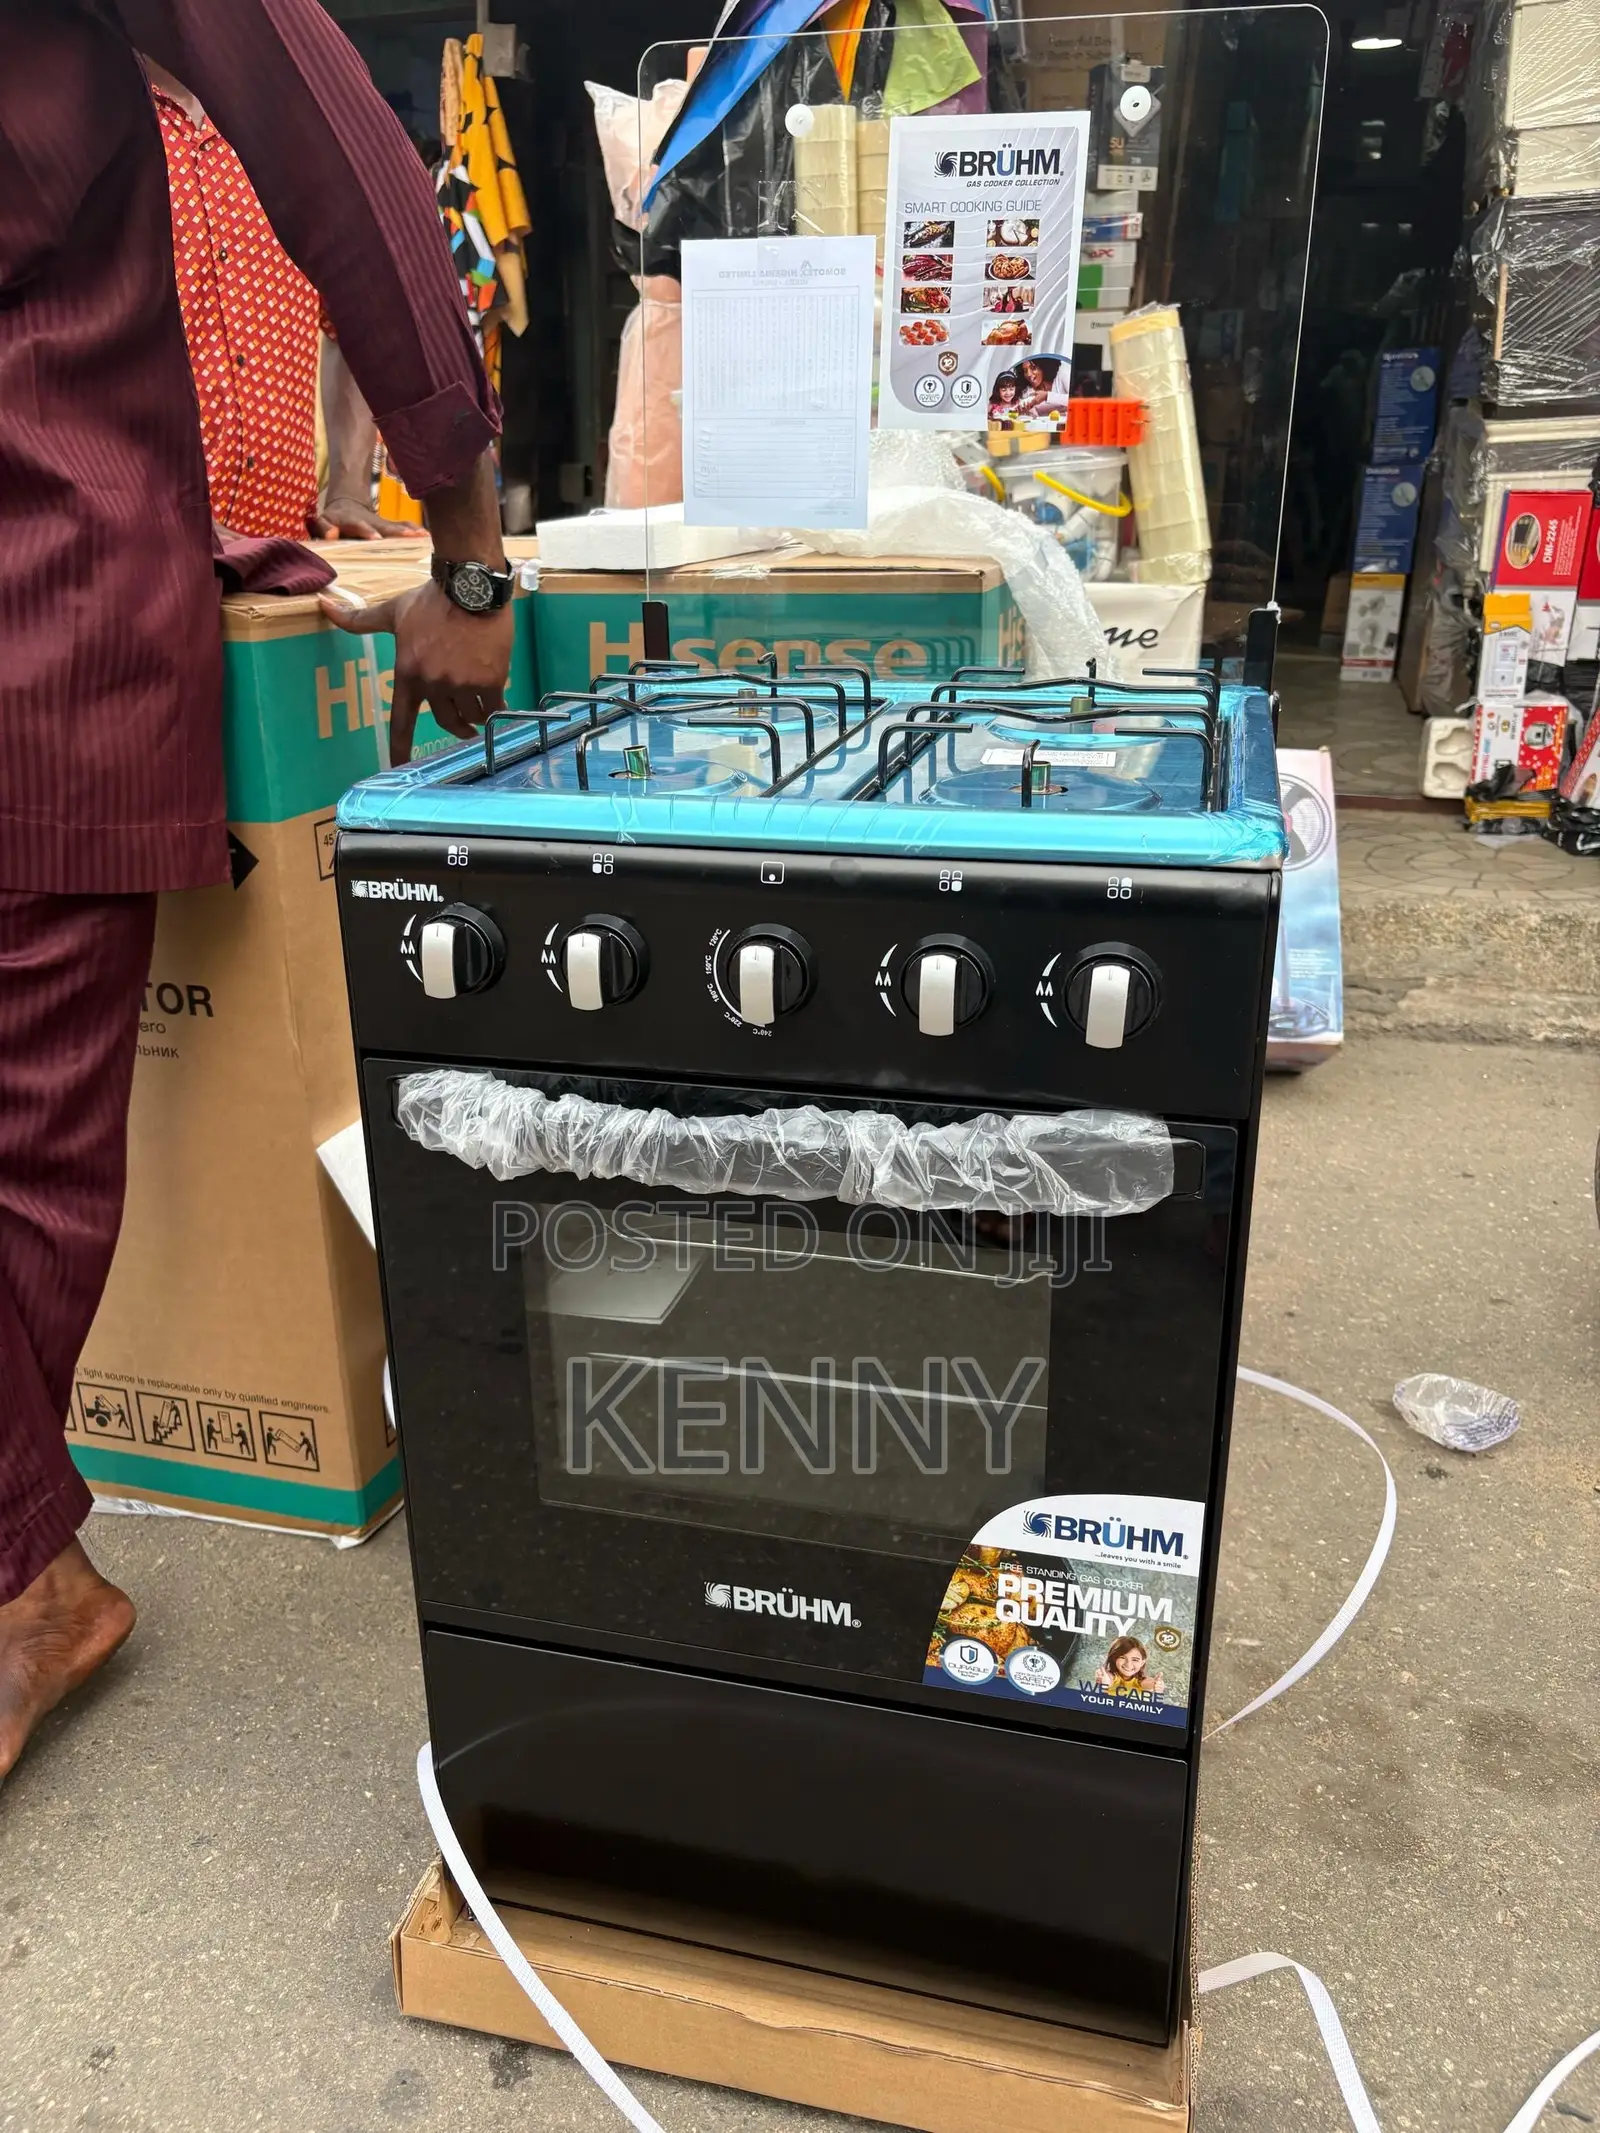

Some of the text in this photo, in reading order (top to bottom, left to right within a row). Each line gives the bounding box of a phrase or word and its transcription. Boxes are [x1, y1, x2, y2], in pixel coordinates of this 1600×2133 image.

[966, 178, 1061, 188] GAS COOKER COLLECTION
[904, 200, 1042, 214] SMART COOKING GUIDE
[589, 621, 928, 682] Hsense
[83, 1368, 103, 1380] light
[105, 1372, 135, 1384] source
[138, 1376, 145, 1386] is
[147, 1378, 201, 1395] replaceable
[203, 1386, 223, 1399] only
[224, 1390, 236, 1401] by
[239, 1392, 279, 1407] qualified
[1124, 1554, 1138, 1564] you
[1138, 1556, 1156, 1566] with
[1163, 1560, 1182, 1569] smile
[1000, 1562, 1144, 1591] FREE STANDING GAS COOKER
[997, 1573, 1173, 1623] PREMIUM
[995, 1598, 1138, 1638] QUALITY
[1013, 1674, 1055, 1686] SAFETY
[1079, 1679, 1165, 1703] WE CARE
[1080, 1694, 1164, 1715] YOUR FAMILY
